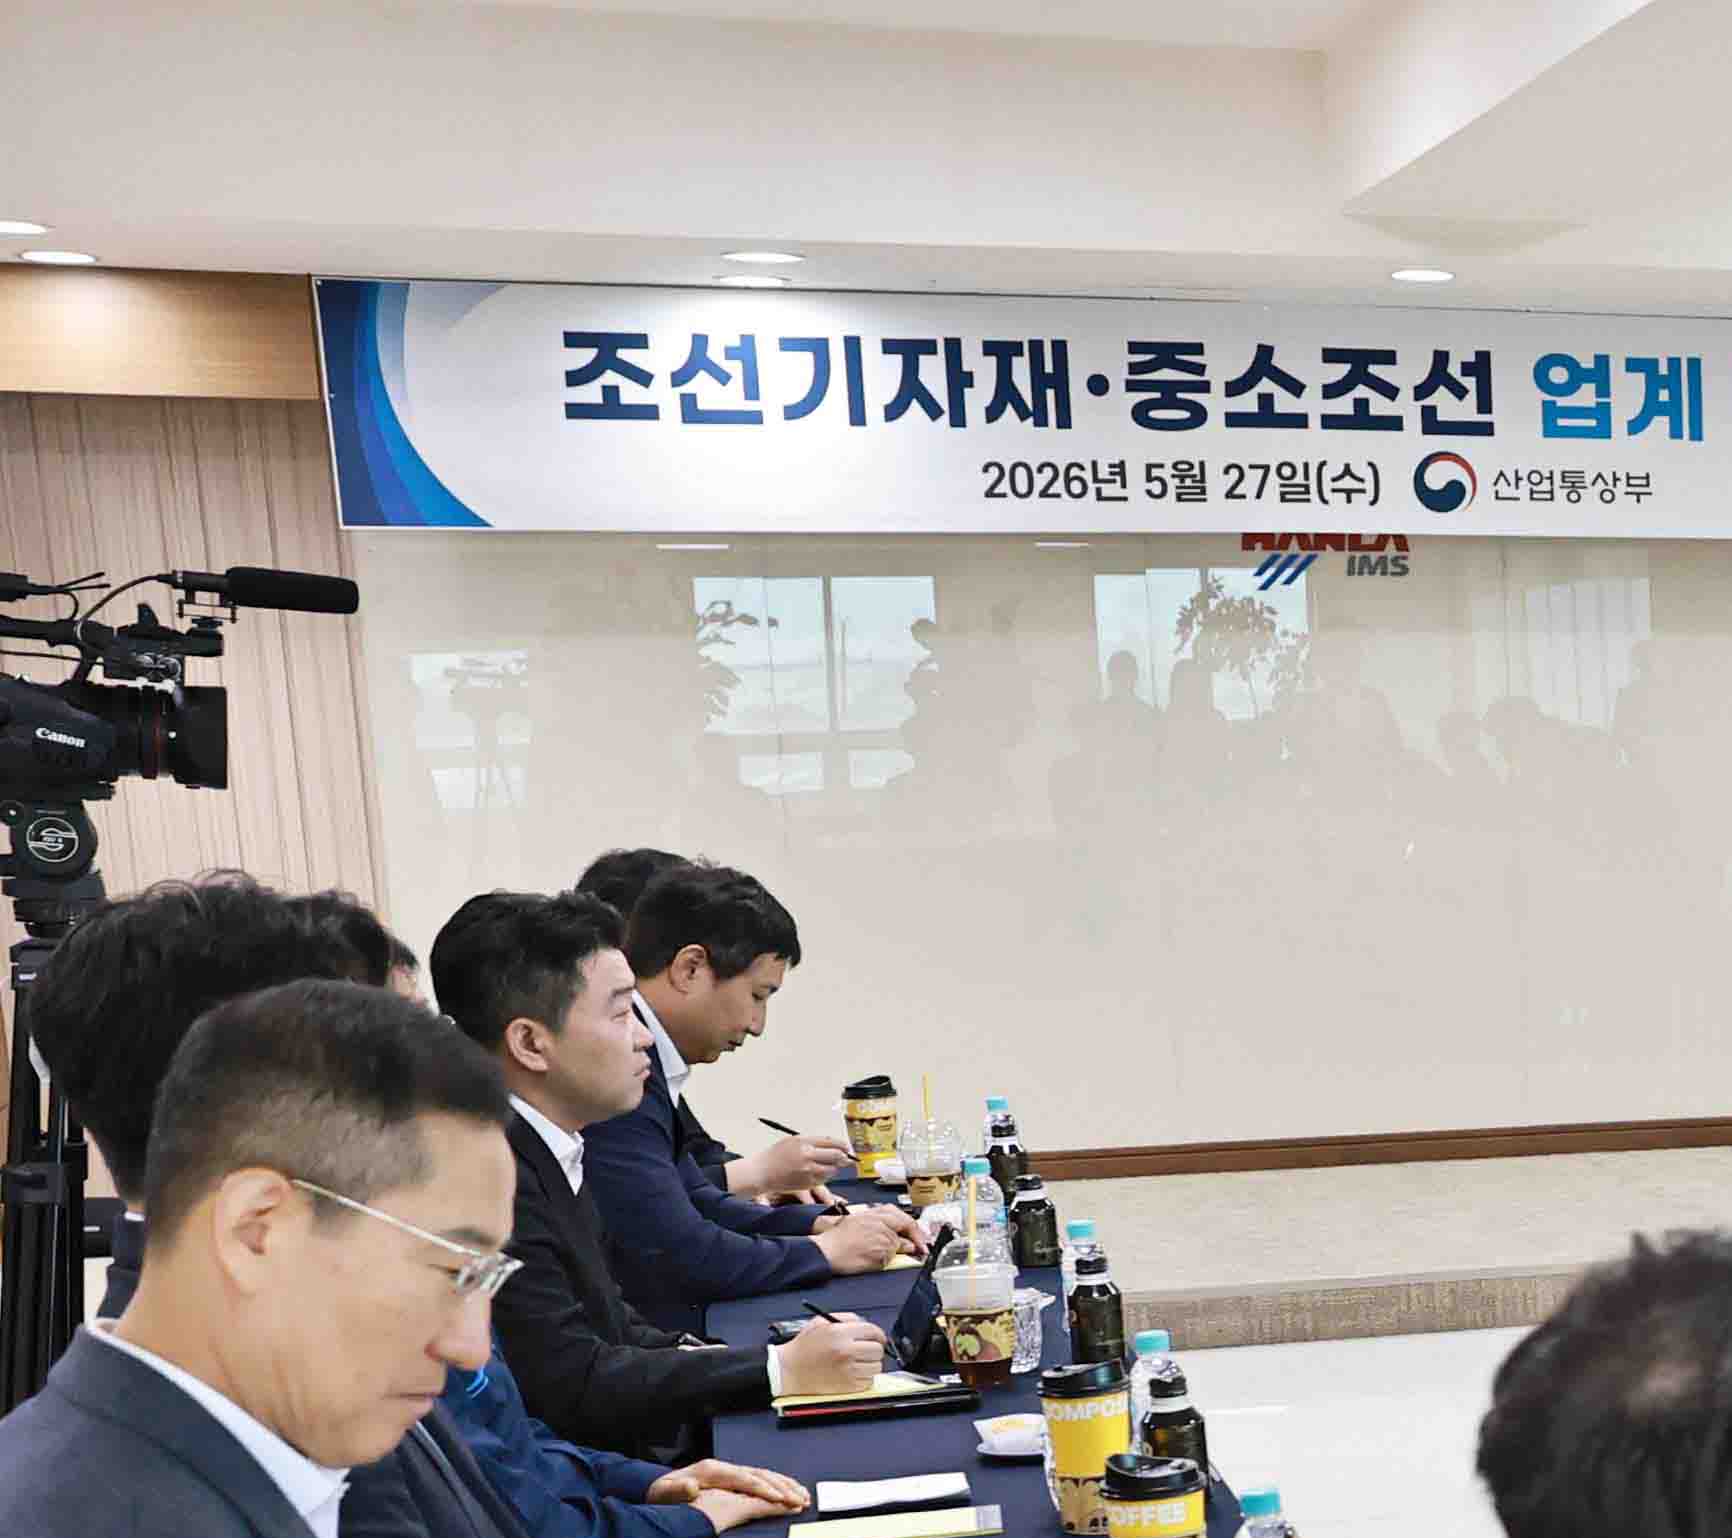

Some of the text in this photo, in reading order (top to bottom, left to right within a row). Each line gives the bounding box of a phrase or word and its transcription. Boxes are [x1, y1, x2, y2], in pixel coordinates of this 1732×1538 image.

[562, 330, 1495, 437] 조선기자재·중소조선
[1532, 352, 1705, 442] 업계
[981, 459, 1381, 507] 2026년 5월 27일(수)
[1492, 468, 1654, 504] 산업통상부
[1347, 555, 1409, 577] IMS
[34, 727, 86, 748] Canon
